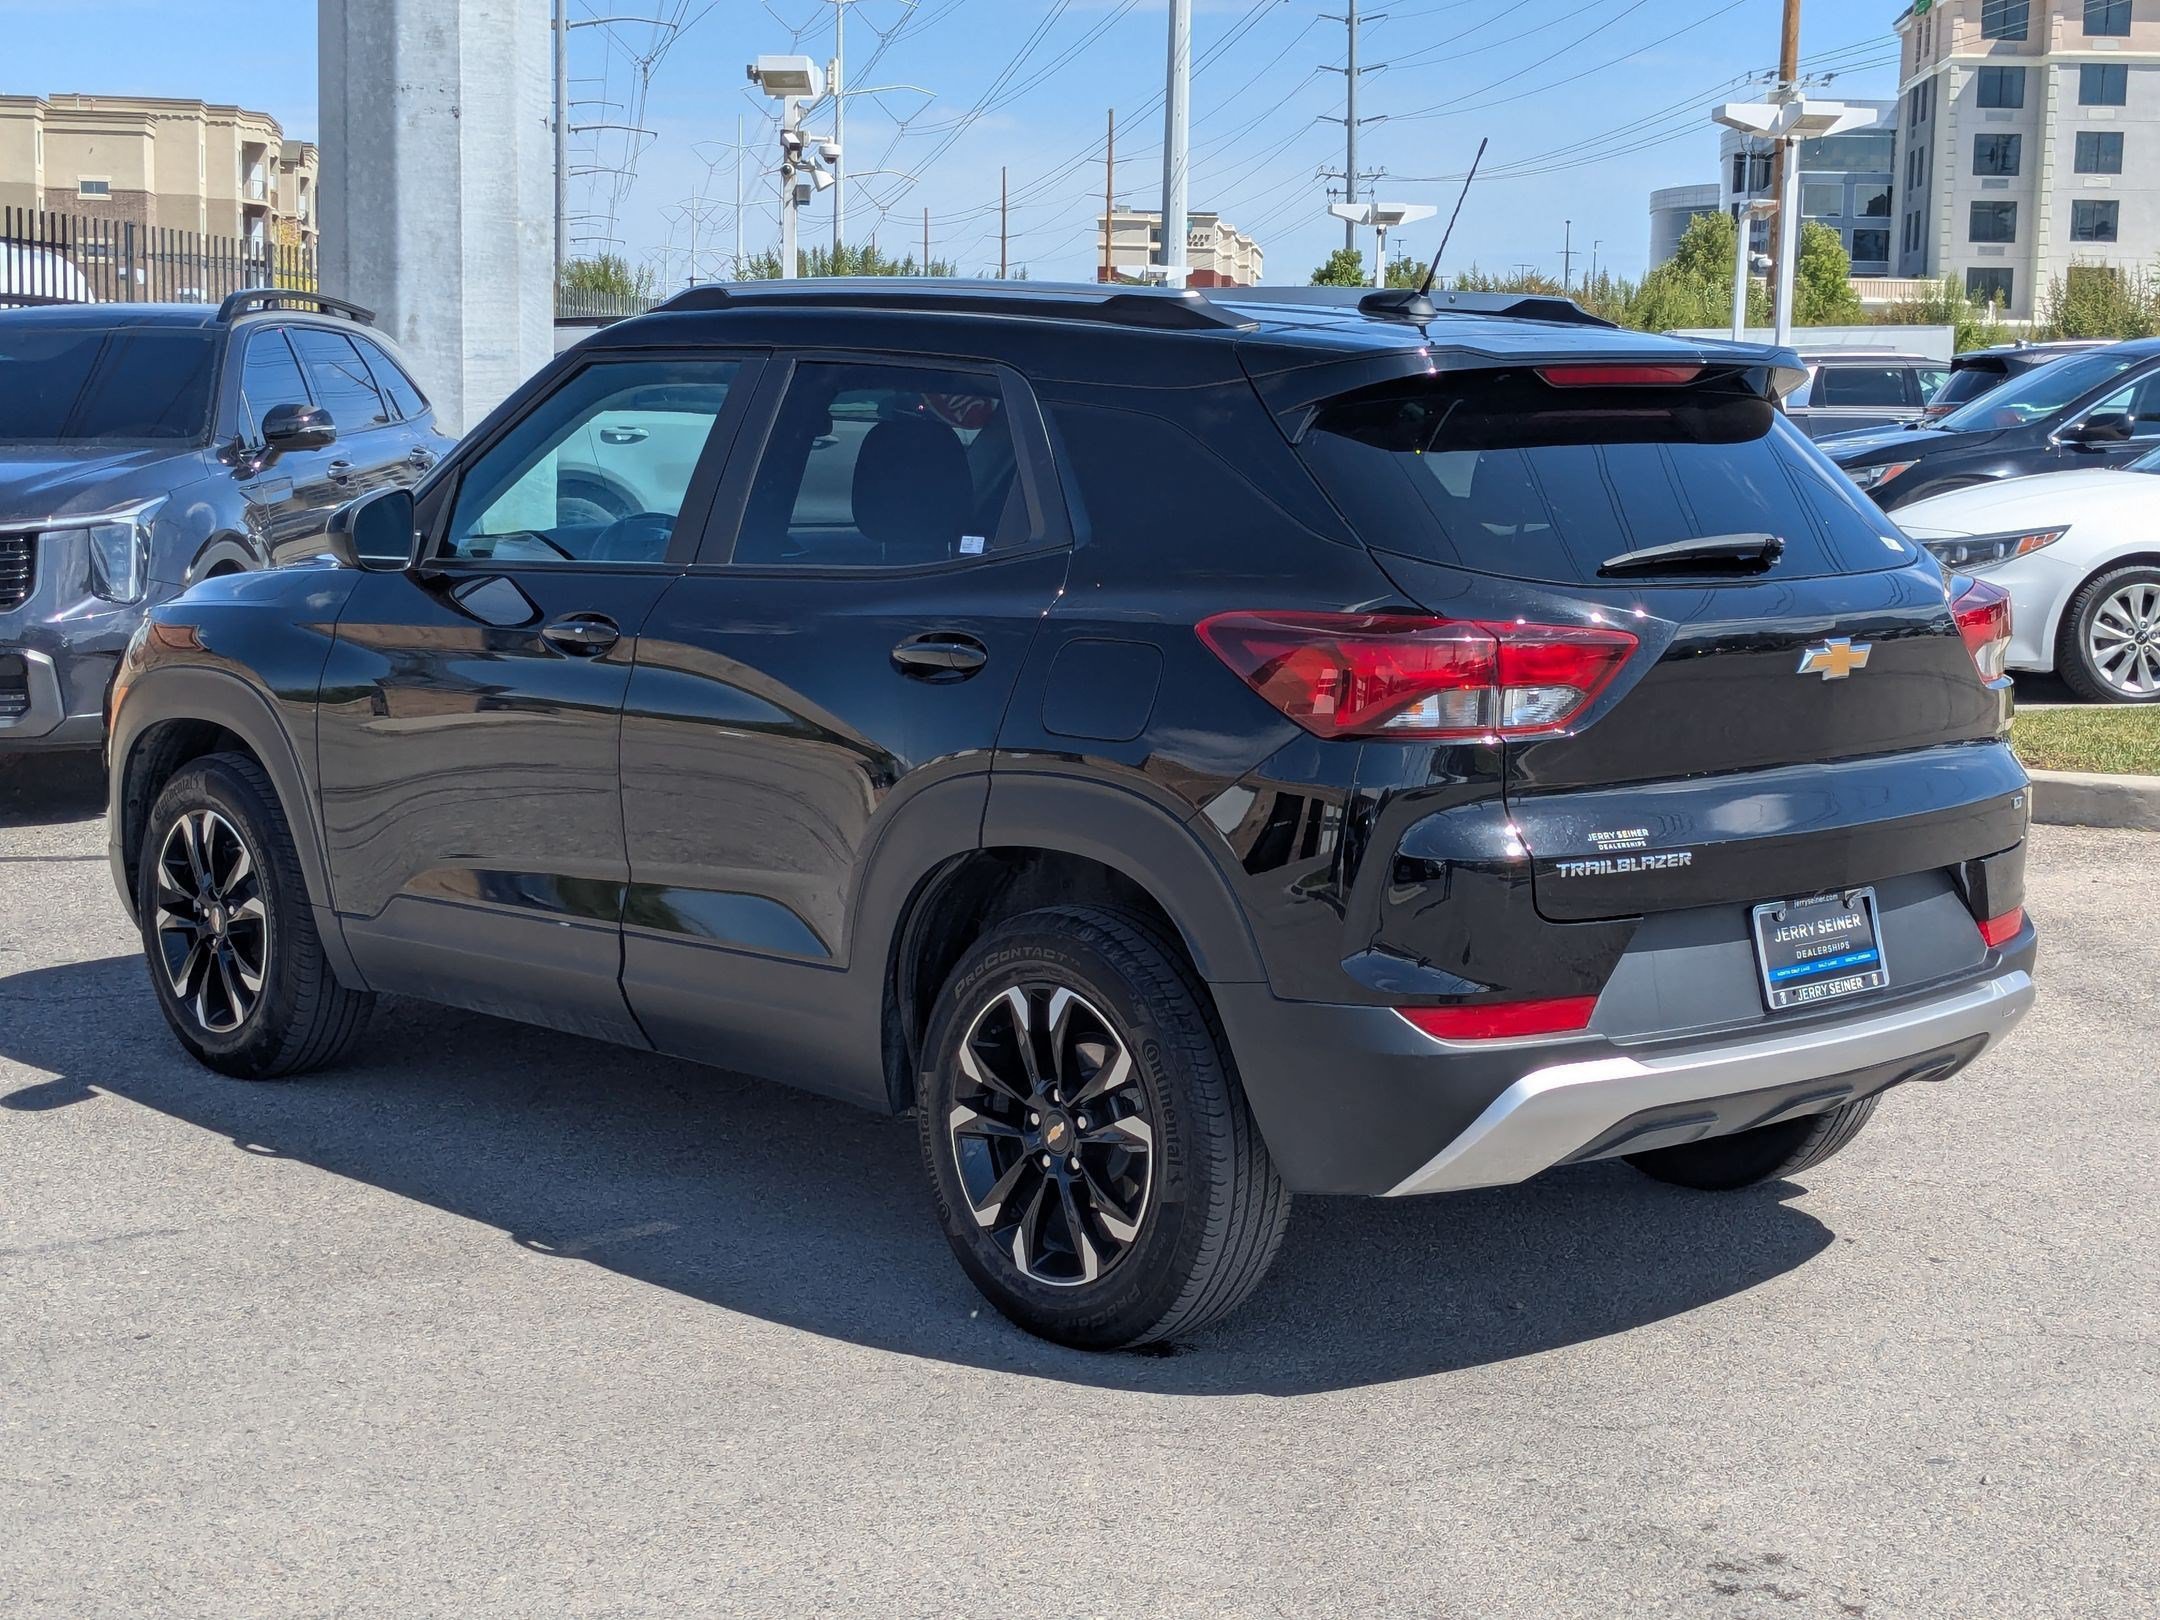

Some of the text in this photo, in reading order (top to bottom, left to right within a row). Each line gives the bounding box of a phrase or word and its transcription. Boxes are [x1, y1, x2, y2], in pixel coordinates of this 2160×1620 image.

[1587, 828, 1649, 842] JERRY SEINER
[1598, 840, 1647, 851] DEALERSHIPS
[1556, 852, 1692, 878] TRAILBLAZER
[1793, 893, 1838, 909] jerryseiner.com
[1774, 913, 1862, 943] JERRY SEINER
[1796, 941, 1850, 960] DEALERSHIPS
[955, 946, 1068, 1000] PROCONTACT
[1798, 977, 1864, 1002] JERRY SEINER
[1141, 1039, 1185, 1166] Continental
